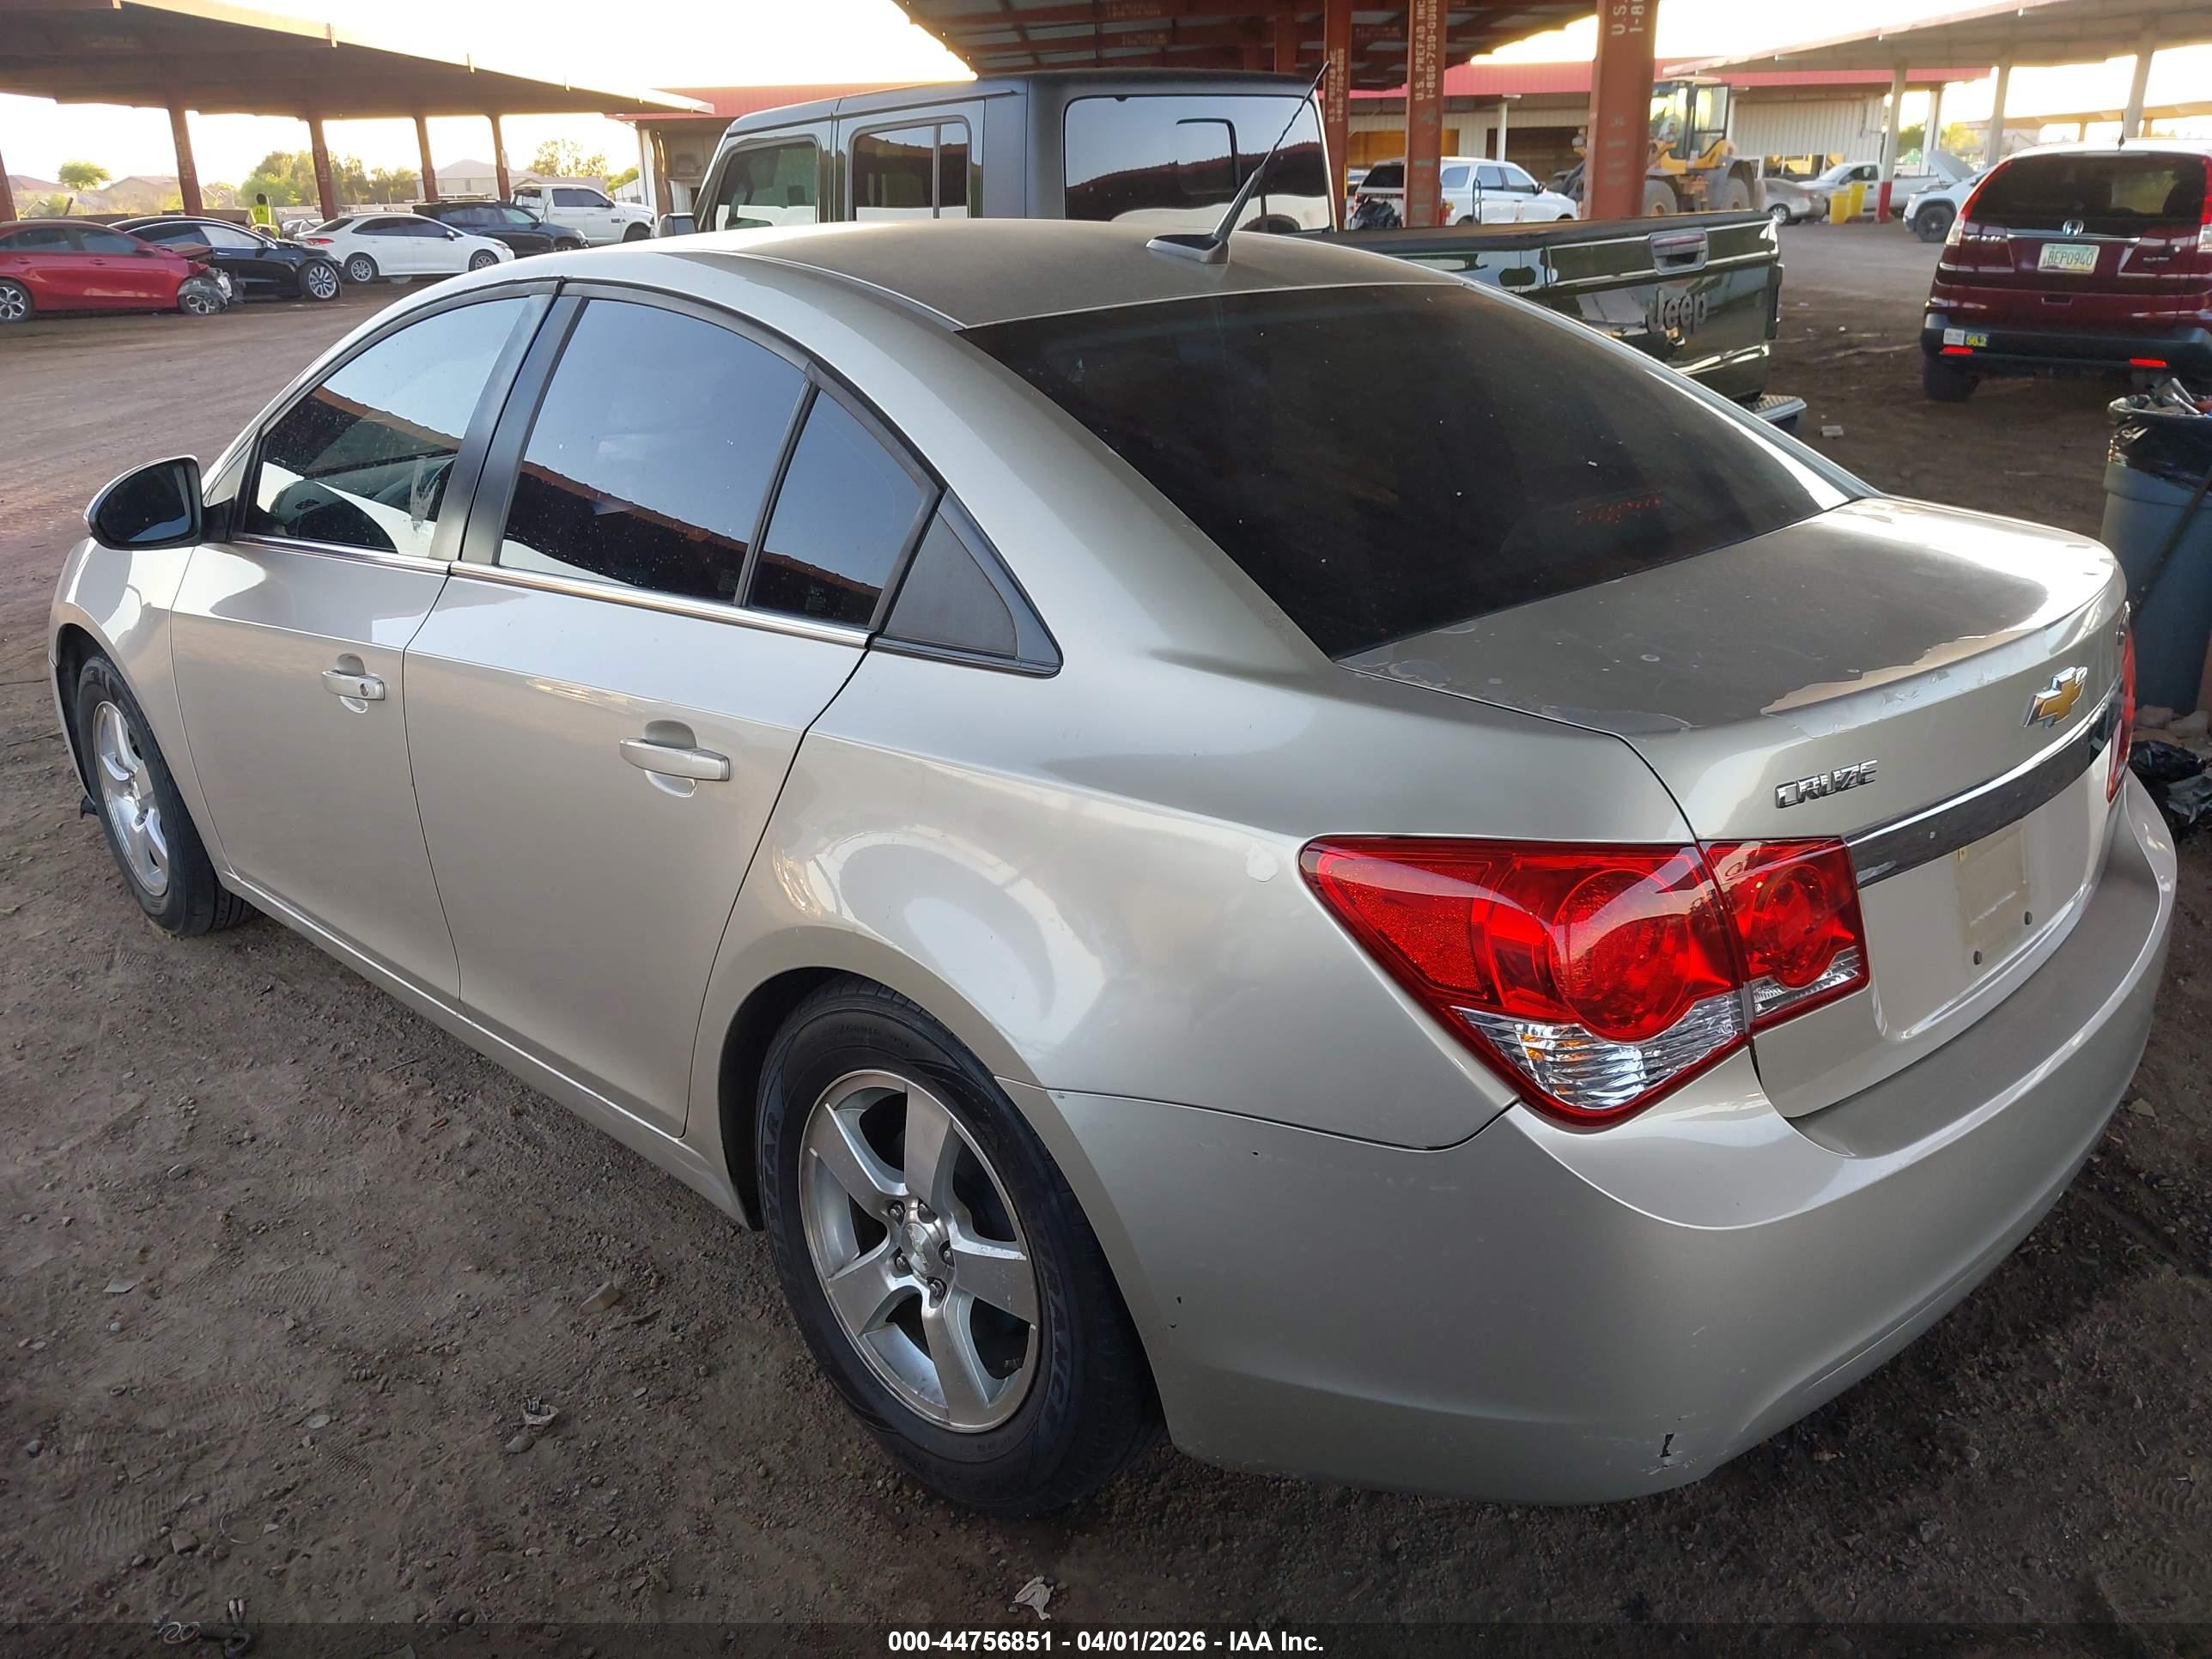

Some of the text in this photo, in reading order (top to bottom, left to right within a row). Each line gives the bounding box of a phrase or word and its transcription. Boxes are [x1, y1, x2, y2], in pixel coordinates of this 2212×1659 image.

[1629, 0, 1644, 33] 1-8
[1645, 289, 1707, 333] Jeep
[1775, 758, 1878, 808] CRUZE
